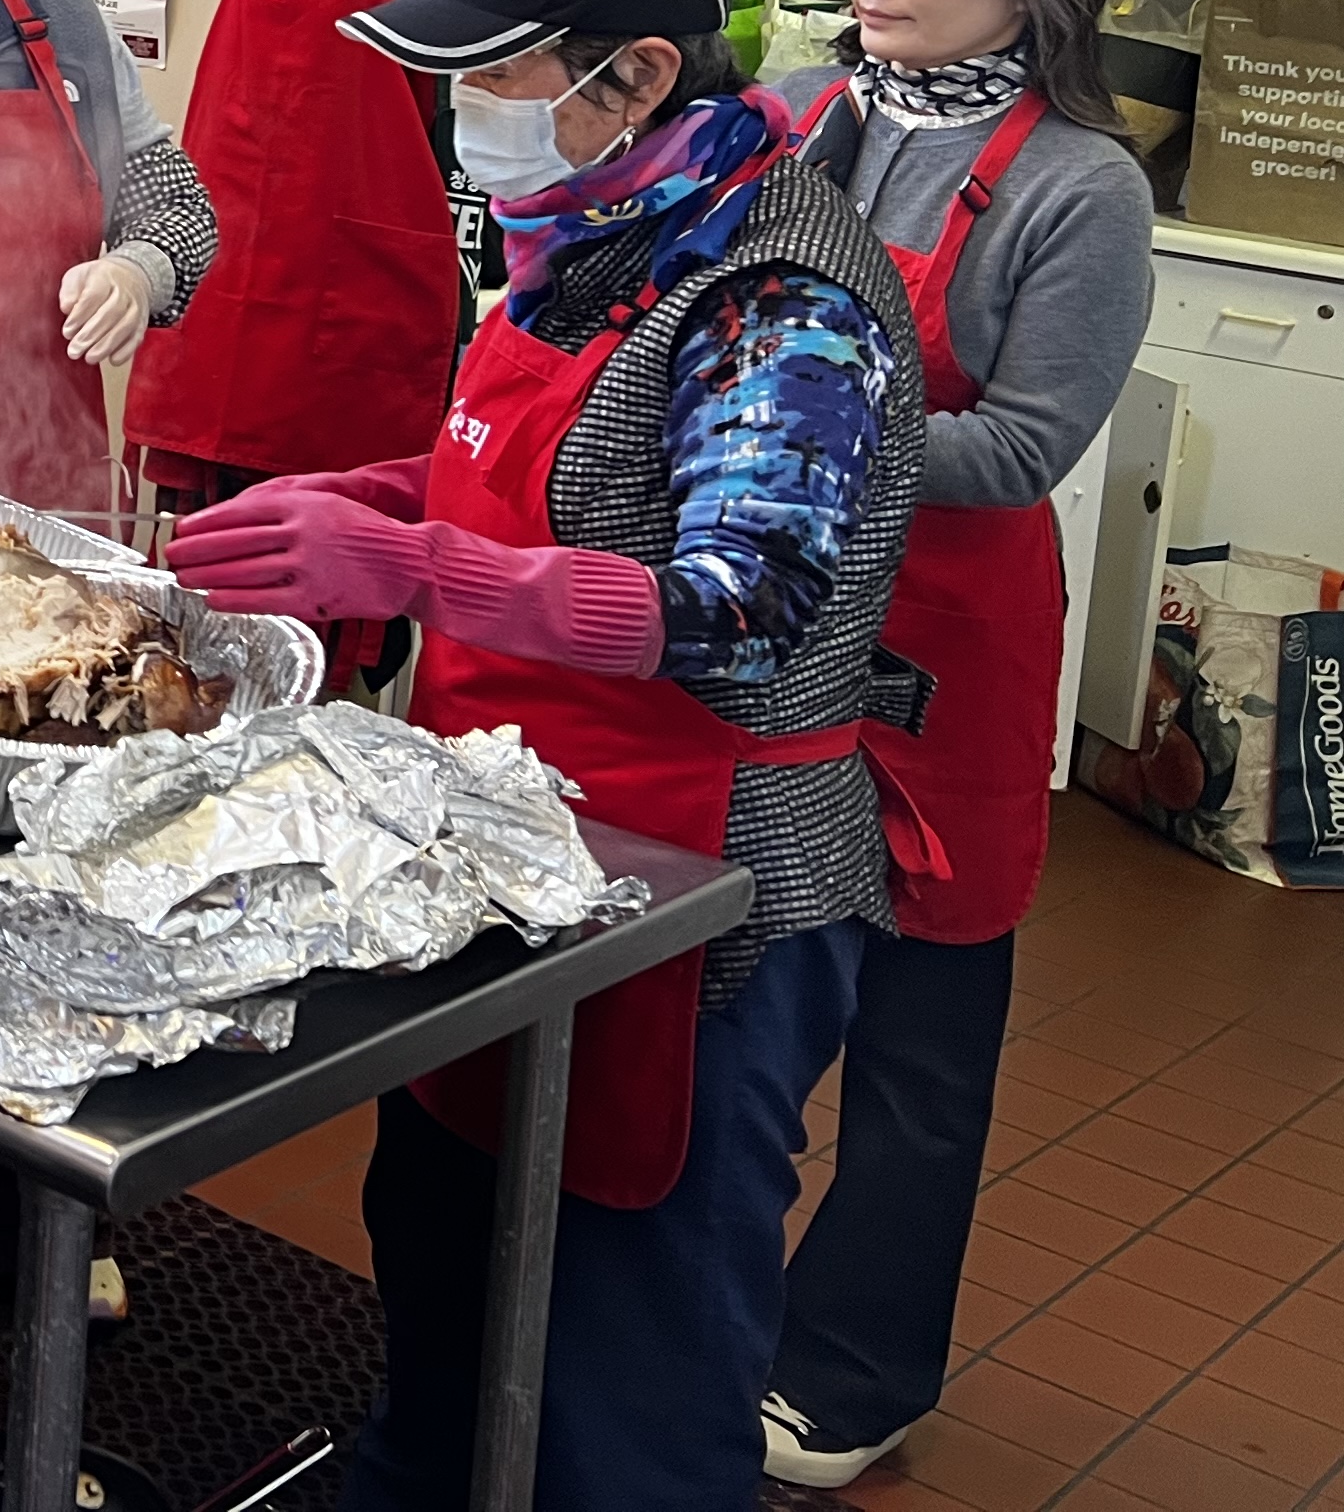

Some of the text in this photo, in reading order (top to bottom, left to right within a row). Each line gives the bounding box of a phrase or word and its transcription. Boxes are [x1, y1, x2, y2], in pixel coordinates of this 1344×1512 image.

[1222, 55, 1299, 79] Thank
[1240, 108, 1296, 128] your
[1250, 159, 1337, 182] grocer!
[1311, 657, 1344, 858] HomeGoods
